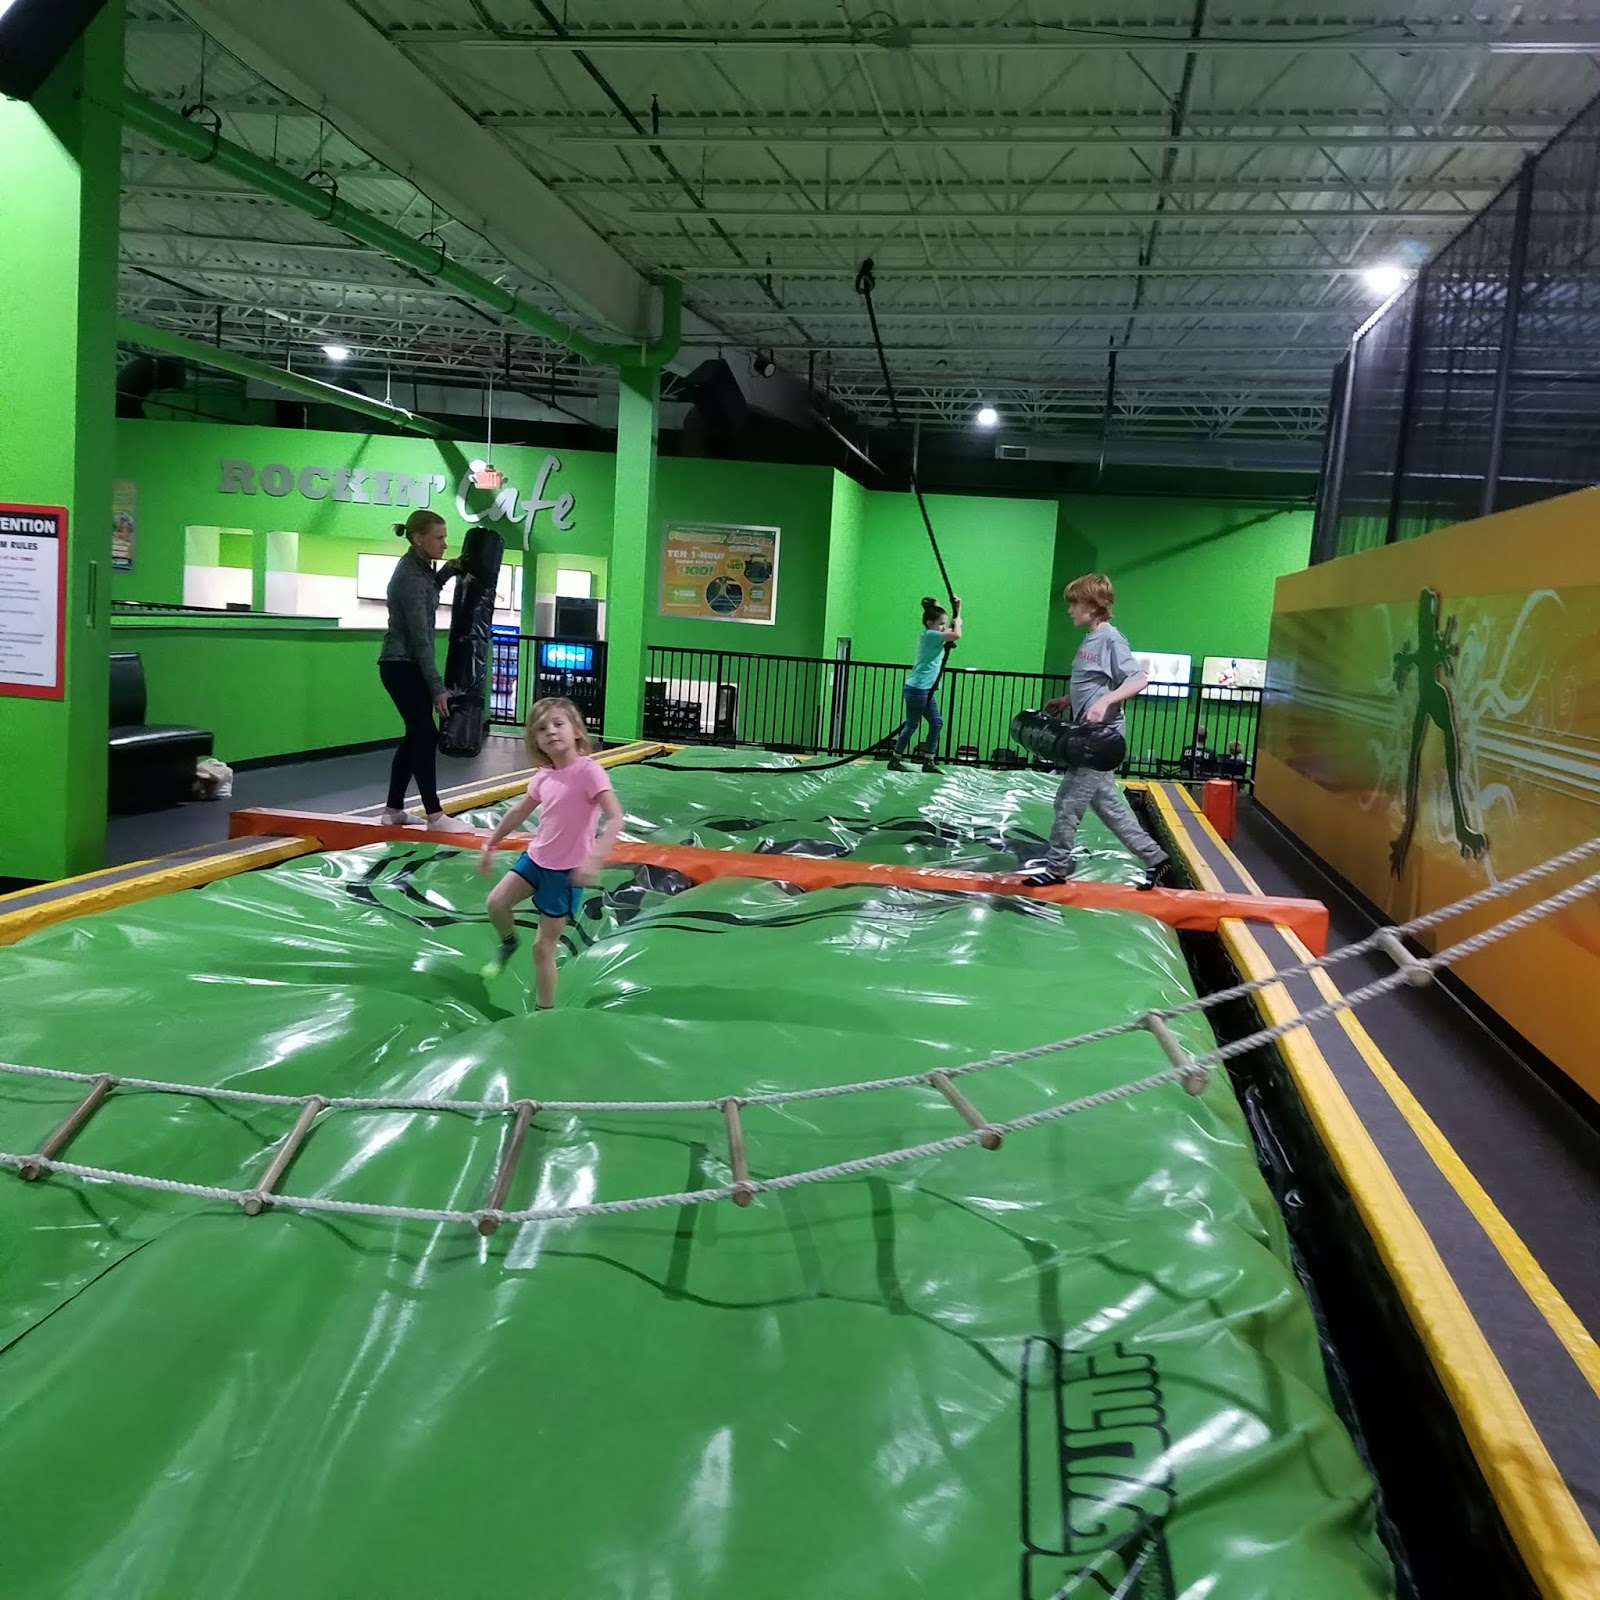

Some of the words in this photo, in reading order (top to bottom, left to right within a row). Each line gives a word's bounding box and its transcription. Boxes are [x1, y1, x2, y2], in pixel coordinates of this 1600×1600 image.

[219, 459, 447, 508] ROCKIN'
[0, 517, 56, 534] ENTION
[10, 541, 38, 551] RULES
[667, 549, 687, 558] TEN
